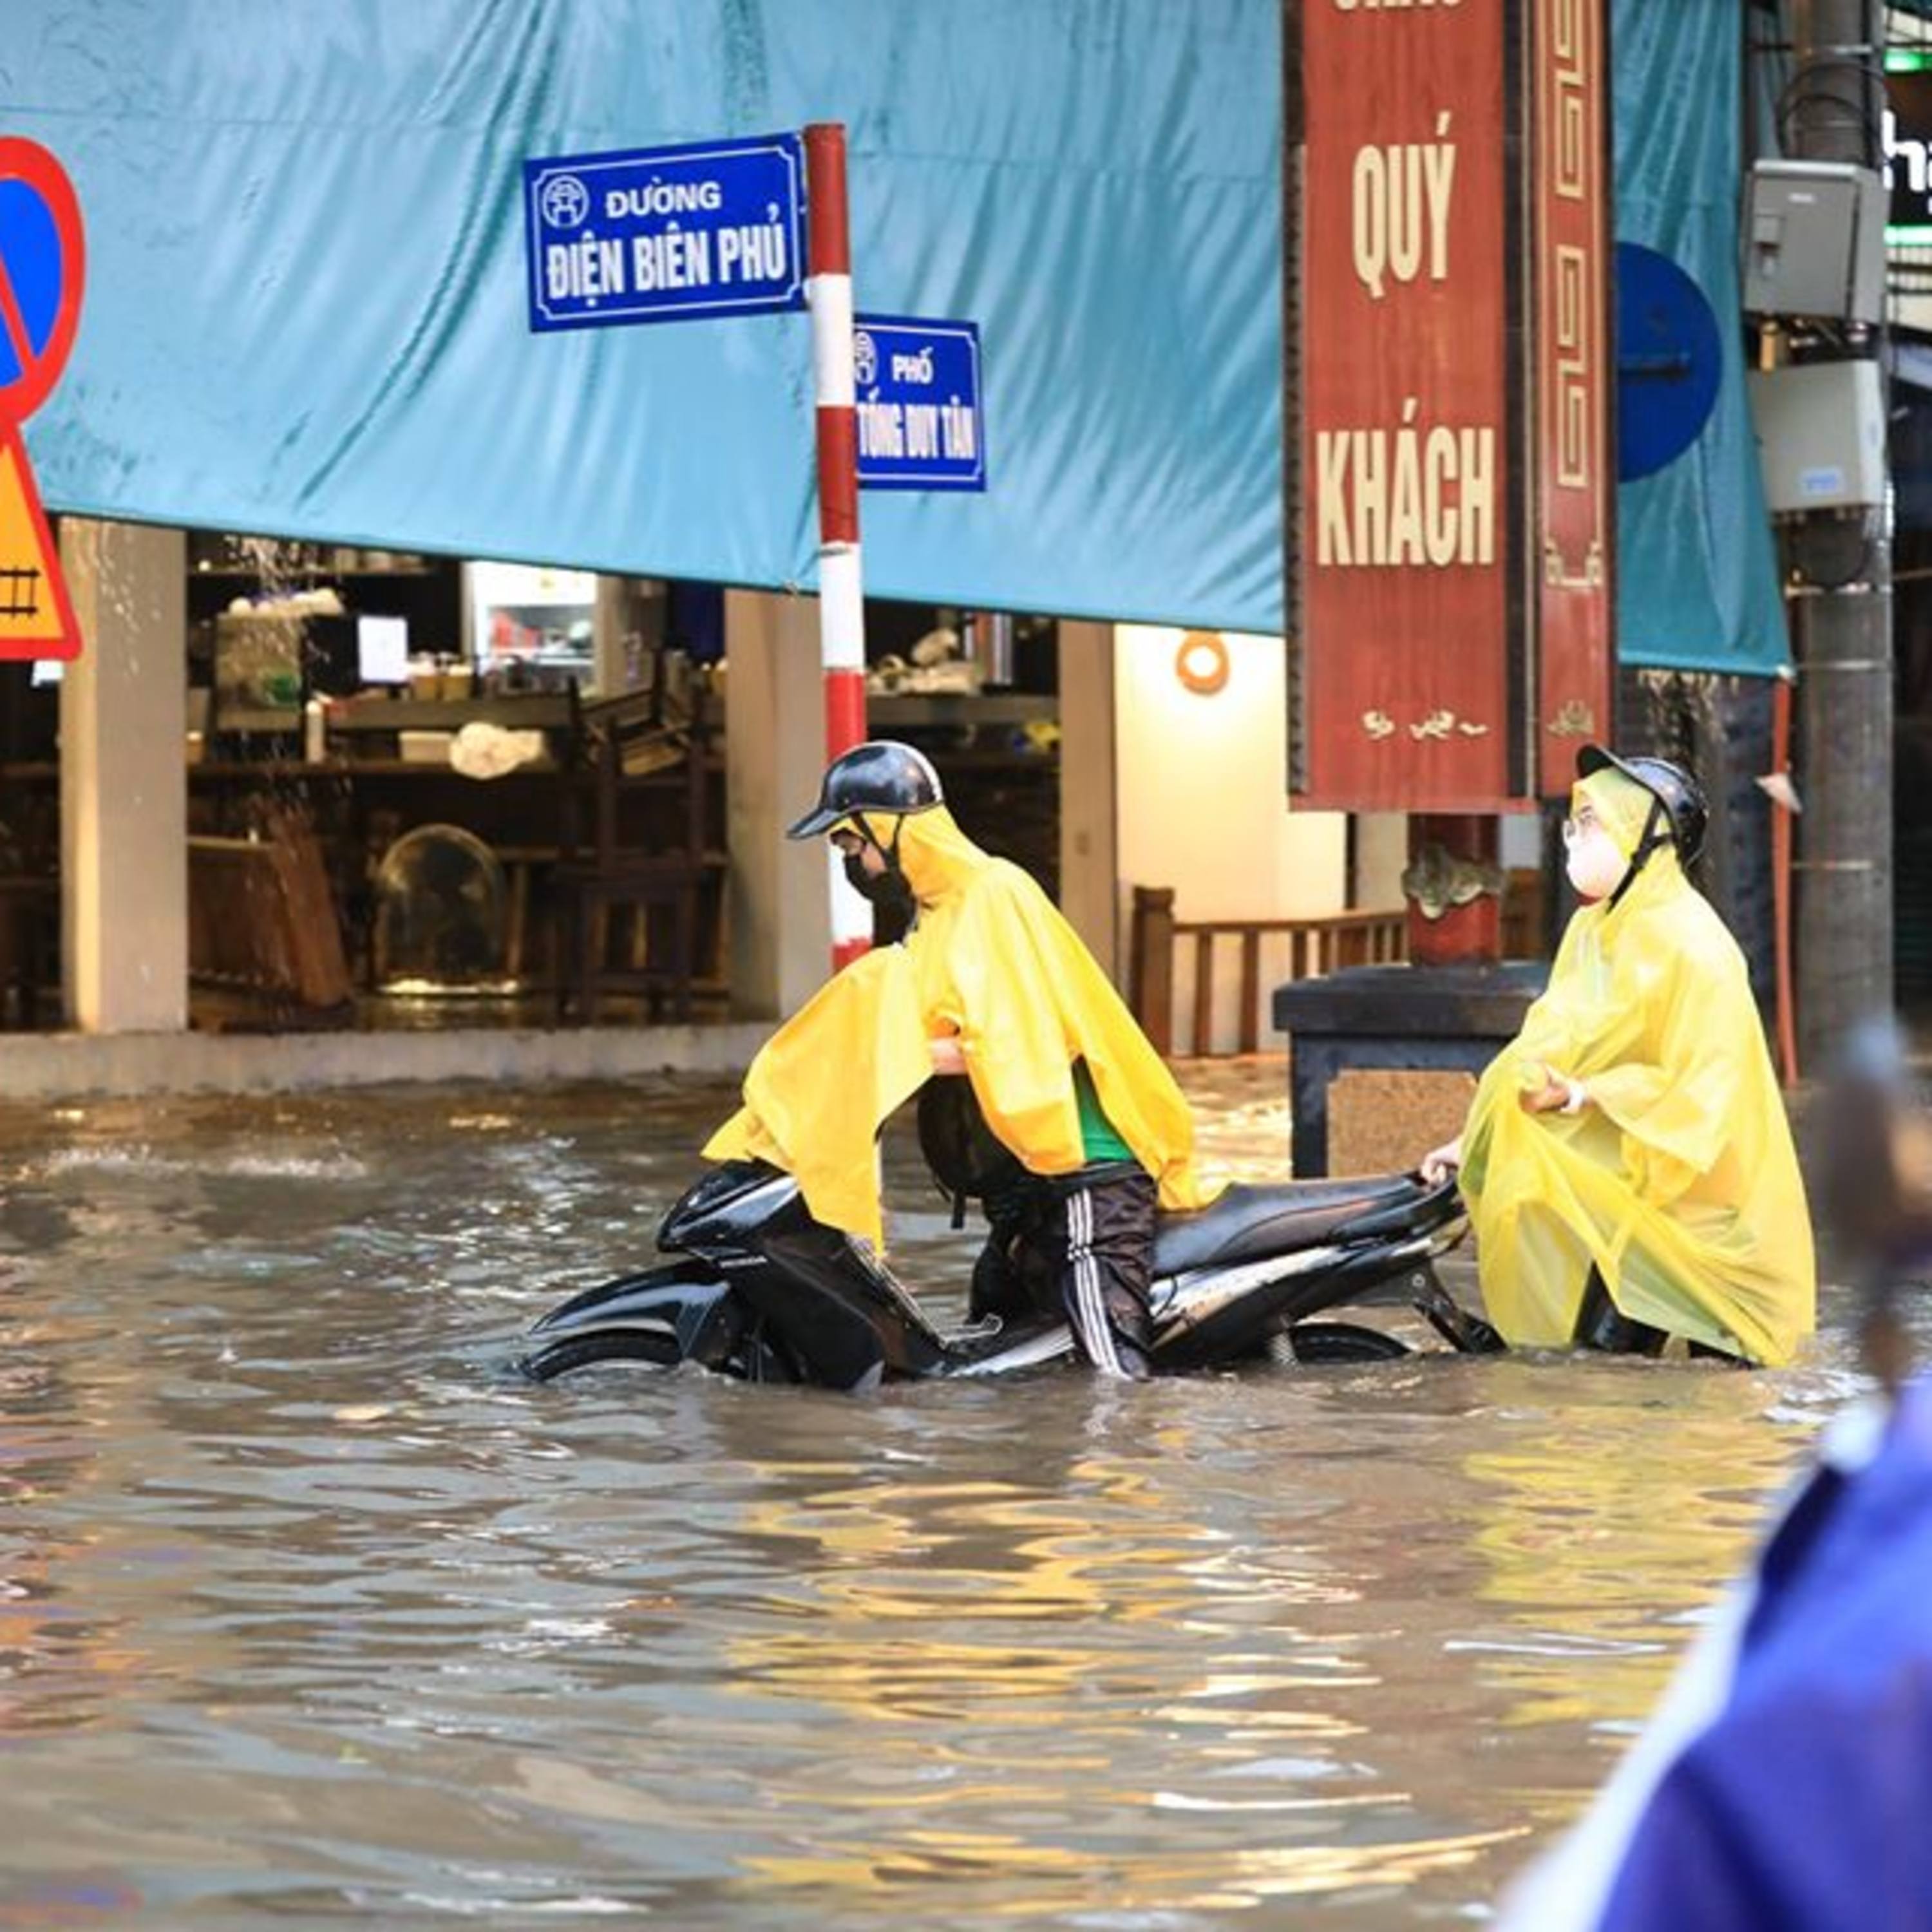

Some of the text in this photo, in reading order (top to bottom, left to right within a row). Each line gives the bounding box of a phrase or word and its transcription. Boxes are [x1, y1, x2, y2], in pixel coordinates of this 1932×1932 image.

[605, 175, 722, 218] ĐƯỜNG
[1354, 111, 1455, 299] QUÝ
[547, 202, 786, 307] ĐIỆN BIÊN PHỦ
[892, 346, 934, 384] PHỐ
[1316, 397, 1495, 567] KHÁCH
